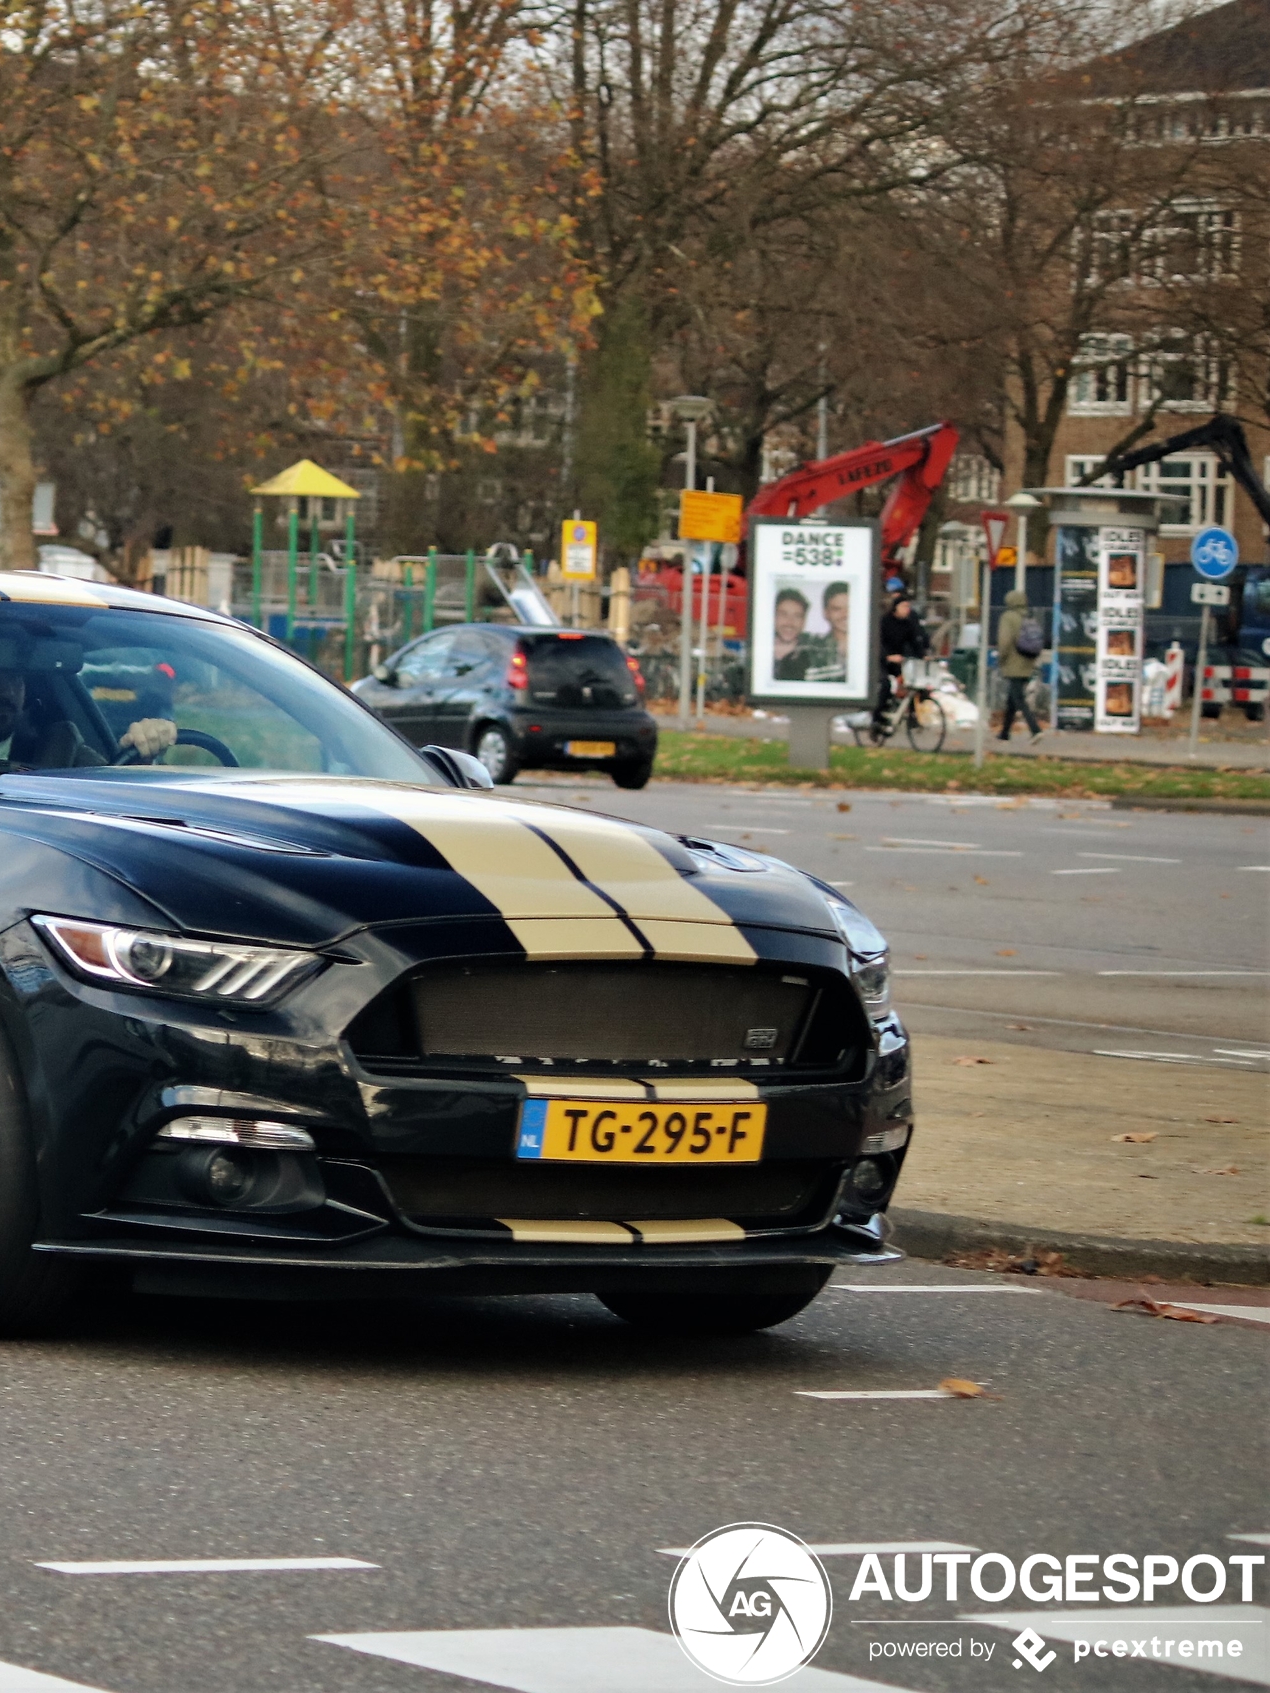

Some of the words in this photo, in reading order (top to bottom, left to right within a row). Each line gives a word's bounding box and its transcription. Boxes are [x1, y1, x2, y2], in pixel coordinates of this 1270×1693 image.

[782, 531, 844, 547] DANCE
[563, 1109, 752, 1155] TG-295-F
[520, 1135, 540, 1149] NL
